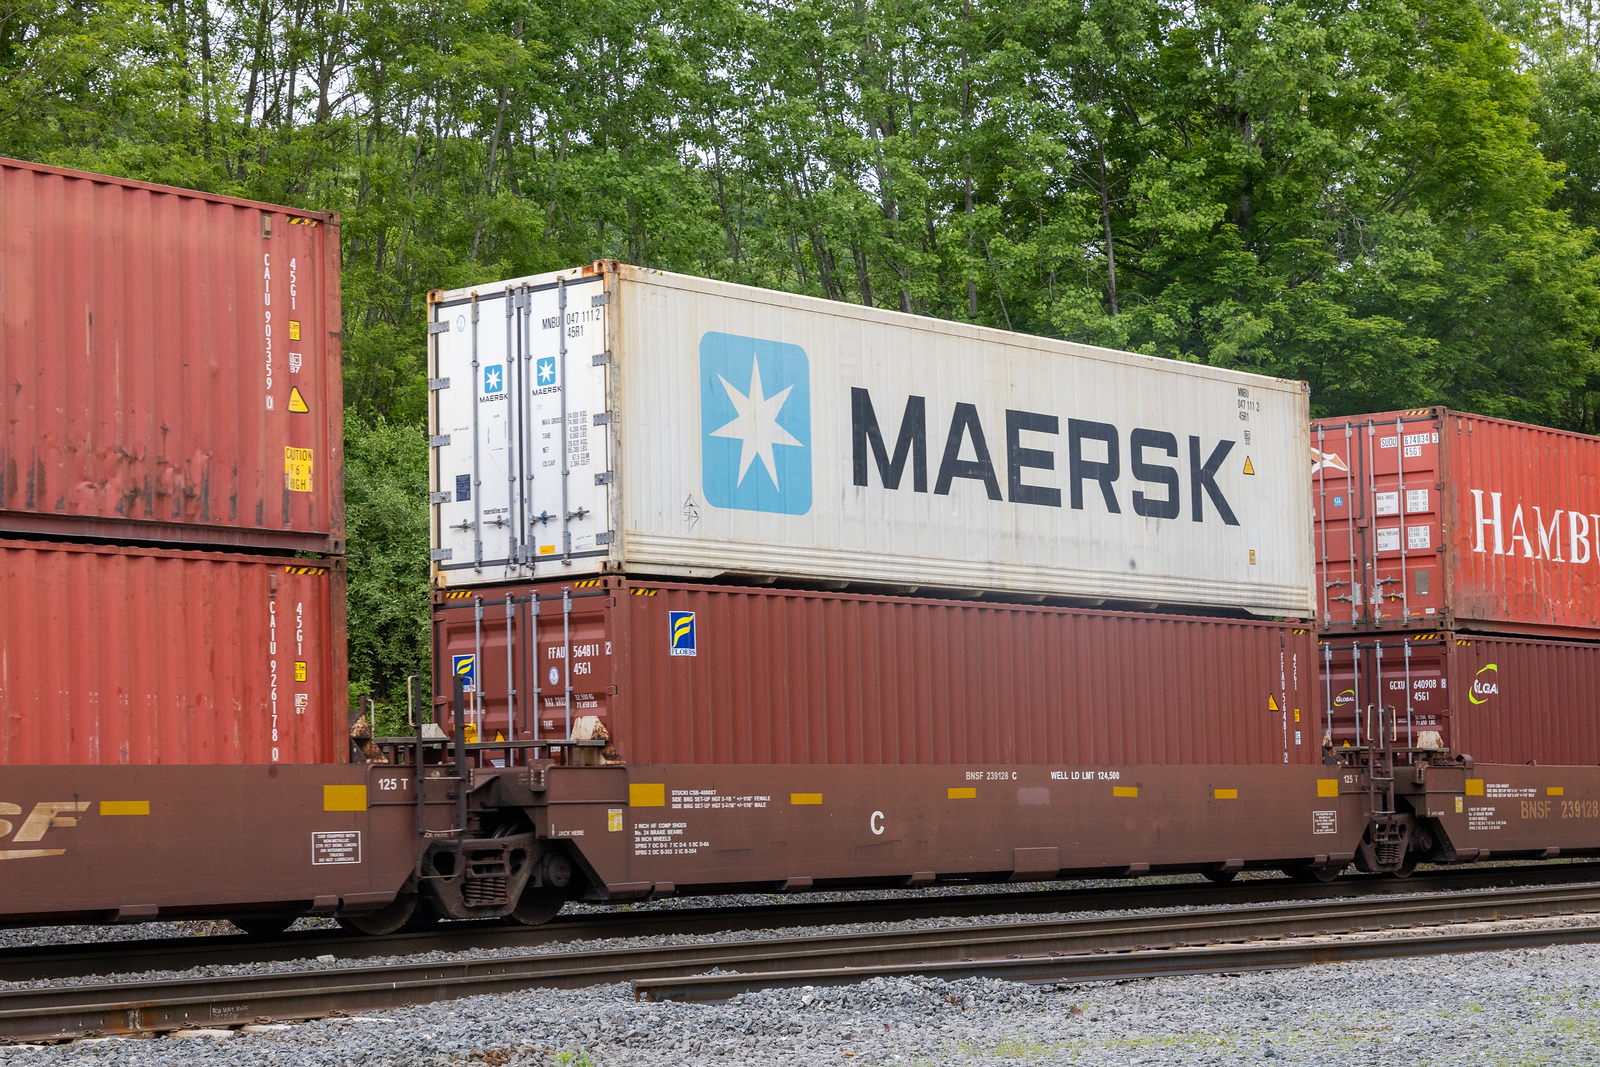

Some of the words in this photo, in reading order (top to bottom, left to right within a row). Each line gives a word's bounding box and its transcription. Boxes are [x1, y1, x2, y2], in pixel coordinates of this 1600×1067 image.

[542, 316, 560, 330] MNBU
[566, 312, 579, 325] 047
[568, 325, 584, 338] 45R1
[532, 386, 562, 396] MAERSK
[479, 392, 508, 403] MAERSK
[1382, 438, 1397, 447] SUDU
[1404, 435, 1430, 445] 674034
[851, 386, 1240, 526] MAERSK
[1405, 447, 1421, 457] 45G1
[548, 646, 566, 659] FFAU
[573, 644, 599, 658] 564811
[605, 641, 612, 655] 2
[574, 662, 591, 675] 45G1
[1390, 681, 1405, 690] GCXU
[1413, 680, 1436, 689] 640908
[1414, 692, 1429, 701] 45G1
[966, 772, 983, 780] BNSF
[986, 772, 1009, 780] 239128
[1012, 772, 1017, 780] C
[1051, 772, 1068, 780] WELL
[1071, 772, 1079, 780] LD
[1082, 772, 1094, 780] LMT
[1097, 772, 1120, 780] 124,500
[1344, 775, 1353, 784] 125
[378, 778, 398, 790] 125
[400, 778, 408, 790] T
[1521, 801, 1551, 819] BNSF
[1561, 800, 1598, 818] 239128
[870, 810, 885, 835] C
